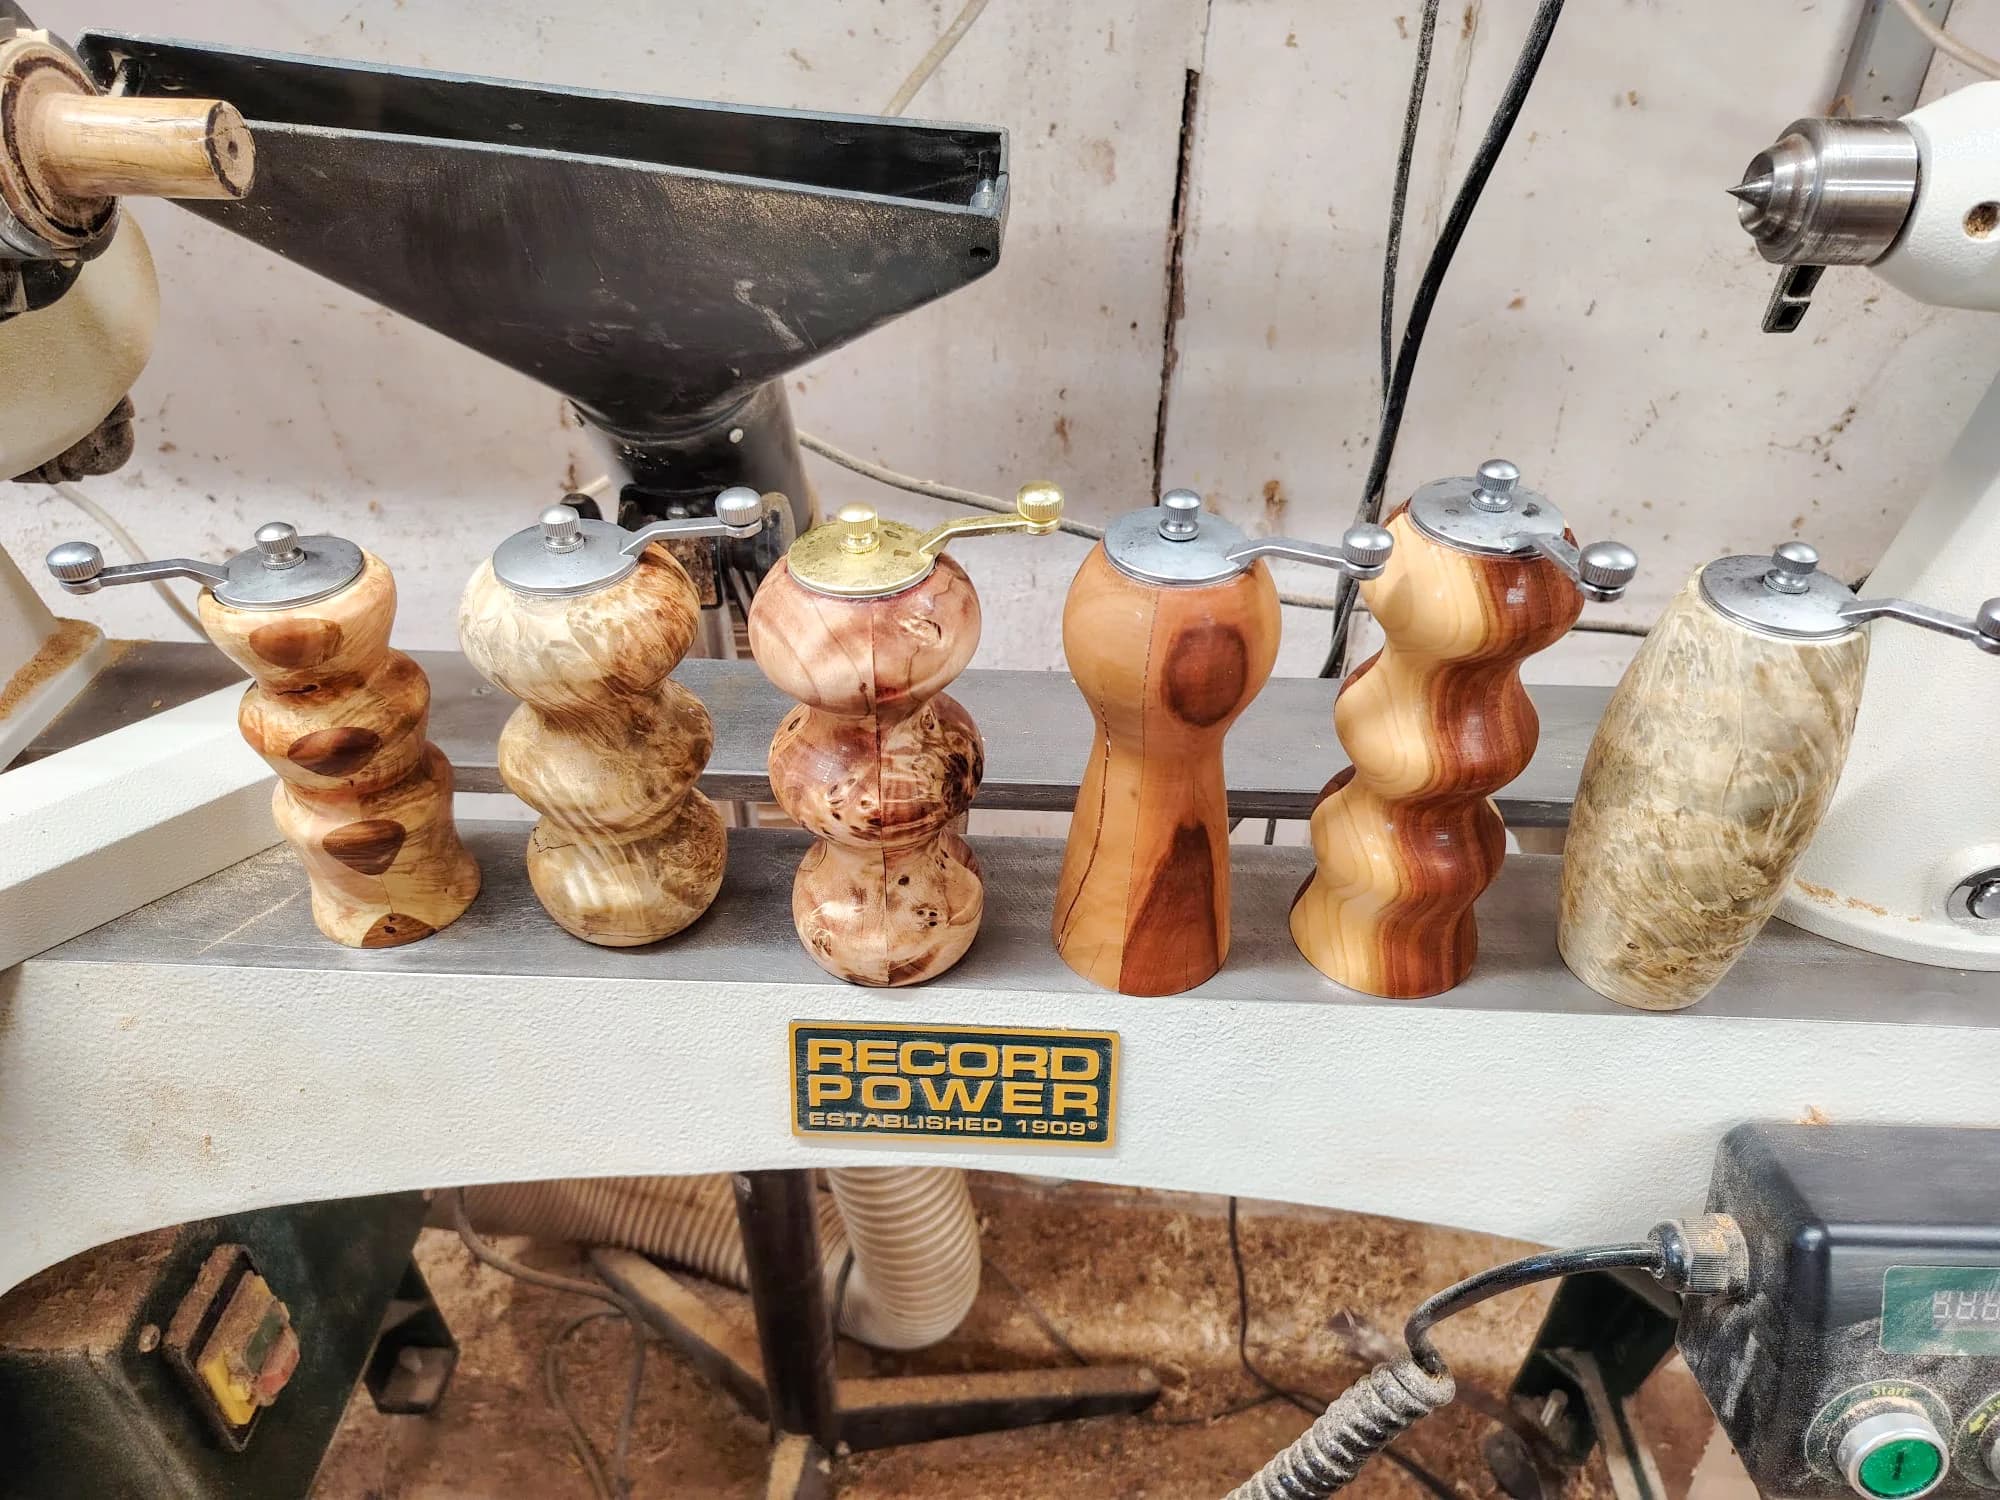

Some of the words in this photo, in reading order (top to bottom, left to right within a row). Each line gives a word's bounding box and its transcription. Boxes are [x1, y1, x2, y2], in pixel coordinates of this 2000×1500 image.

[807, 1038, 1100, 1082] RECORD
[807, 1074, 1099, 1117] POWER
[808, 1111, 1003, 1132] ESTABLISHED
[1871, 1384, 1912, 1397] Start
